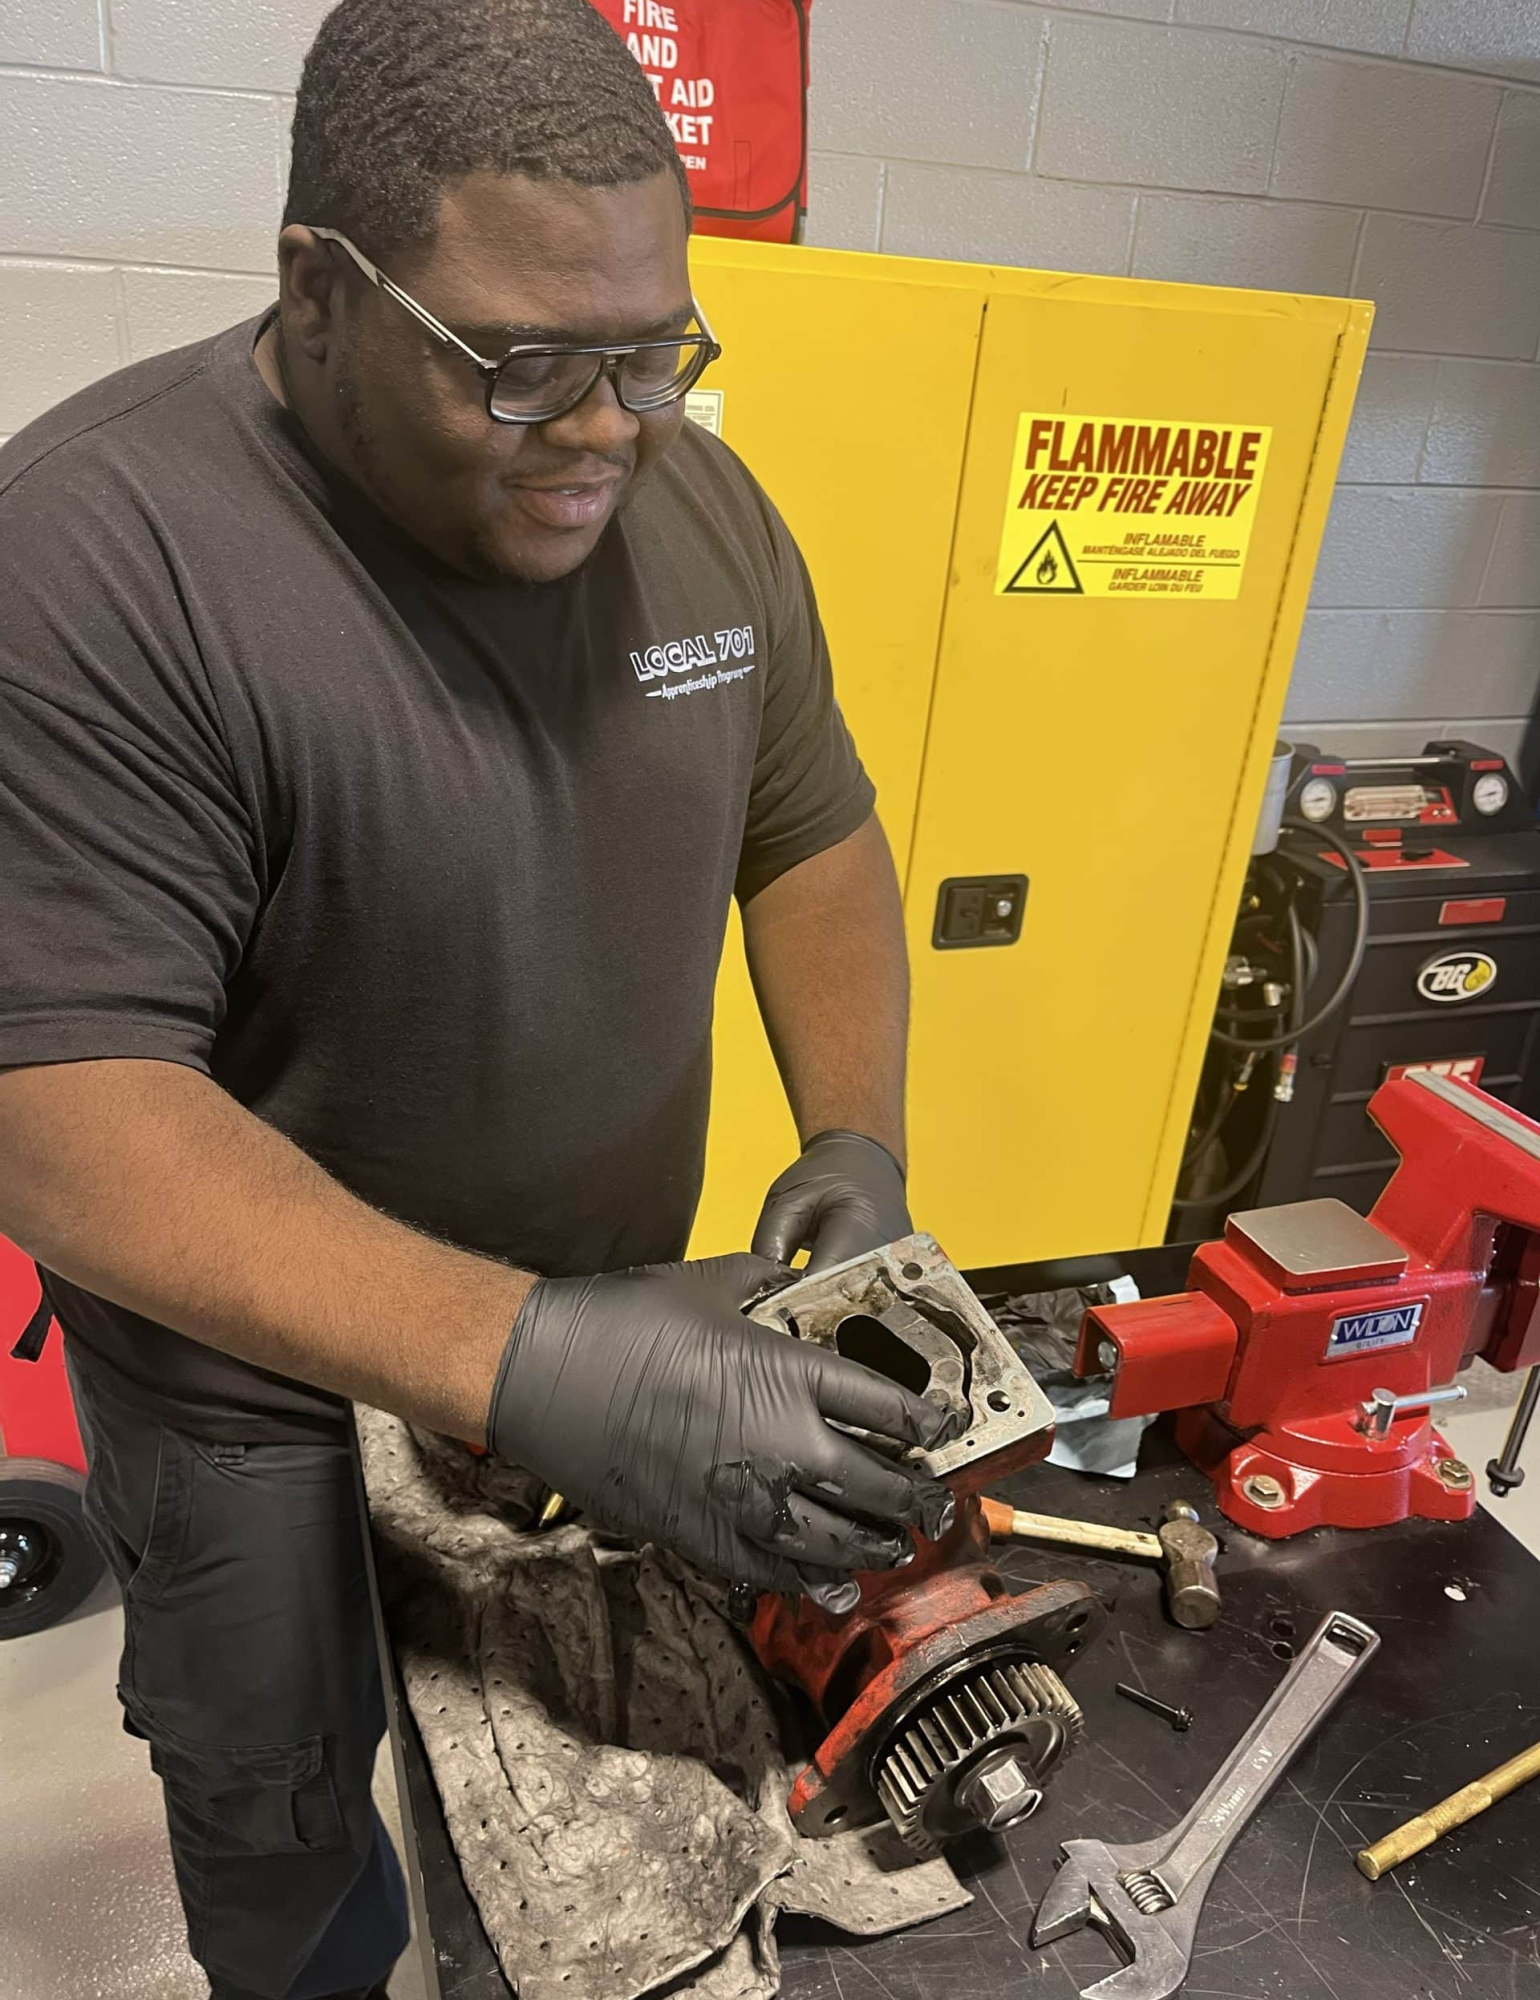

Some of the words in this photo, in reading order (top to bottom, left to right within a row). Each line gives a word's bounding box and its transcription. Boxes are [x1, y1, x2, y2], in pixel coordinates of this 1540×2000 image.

[623, 0, 679, 32] FIRE
[627, 32, 678, 69] AND
[671, 78, 714, 109] AID
[663, 111, 713, 146] KET
[1025, 419, 1263, 480] FLAMMABLE
[1017, 473, 1099, 511] KEEP
[1097, 478, 1169, 514] FIRE
[1163, 481, 1253, 518] AWAY
[1123, 533, 1206, 547] INFLAMABLE
[1147, 547, 1189, 557] ALEJADO
[1190, 548, 1206, 558] DEL
[1209, 549, 1240, 559] FUEGO
[1108, 582, 1147, 592] GARDER
[1148, 583, 1168, 592] LOIN
[1170, 583, 1182, 592] DU
[1184, 584, 1203, 593] FEU
[1112, 568, 1204, 582] INFLAMMABLE
[629, 635, 717, 682] LOCAL
[714, 626, 755, 661] 701
[662, 674, 718, 700] Apprenticeship
